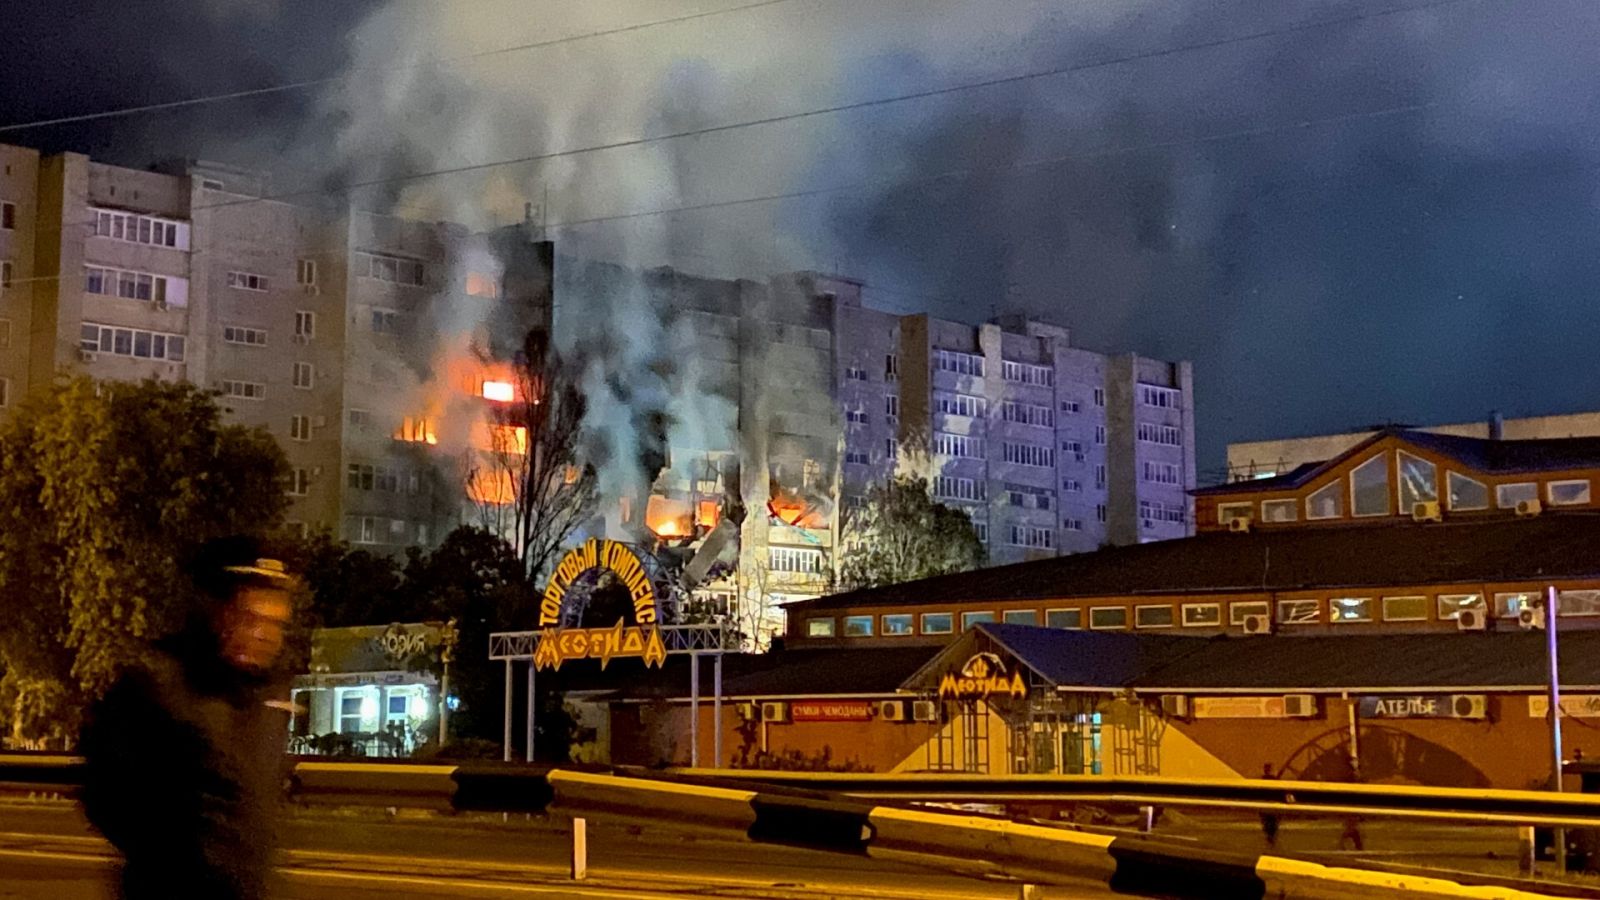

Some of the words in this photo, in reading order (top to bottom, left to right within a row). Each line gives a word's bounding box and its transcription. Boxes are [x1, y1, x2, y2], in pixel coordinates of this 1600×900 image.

[539, 536, 597, 626] ТОРГОВЫЙ
[601, 538, 656, 624] КОМПЛЕКС
[1374, 699, 1437, 714] АТЕЛЬЕ
